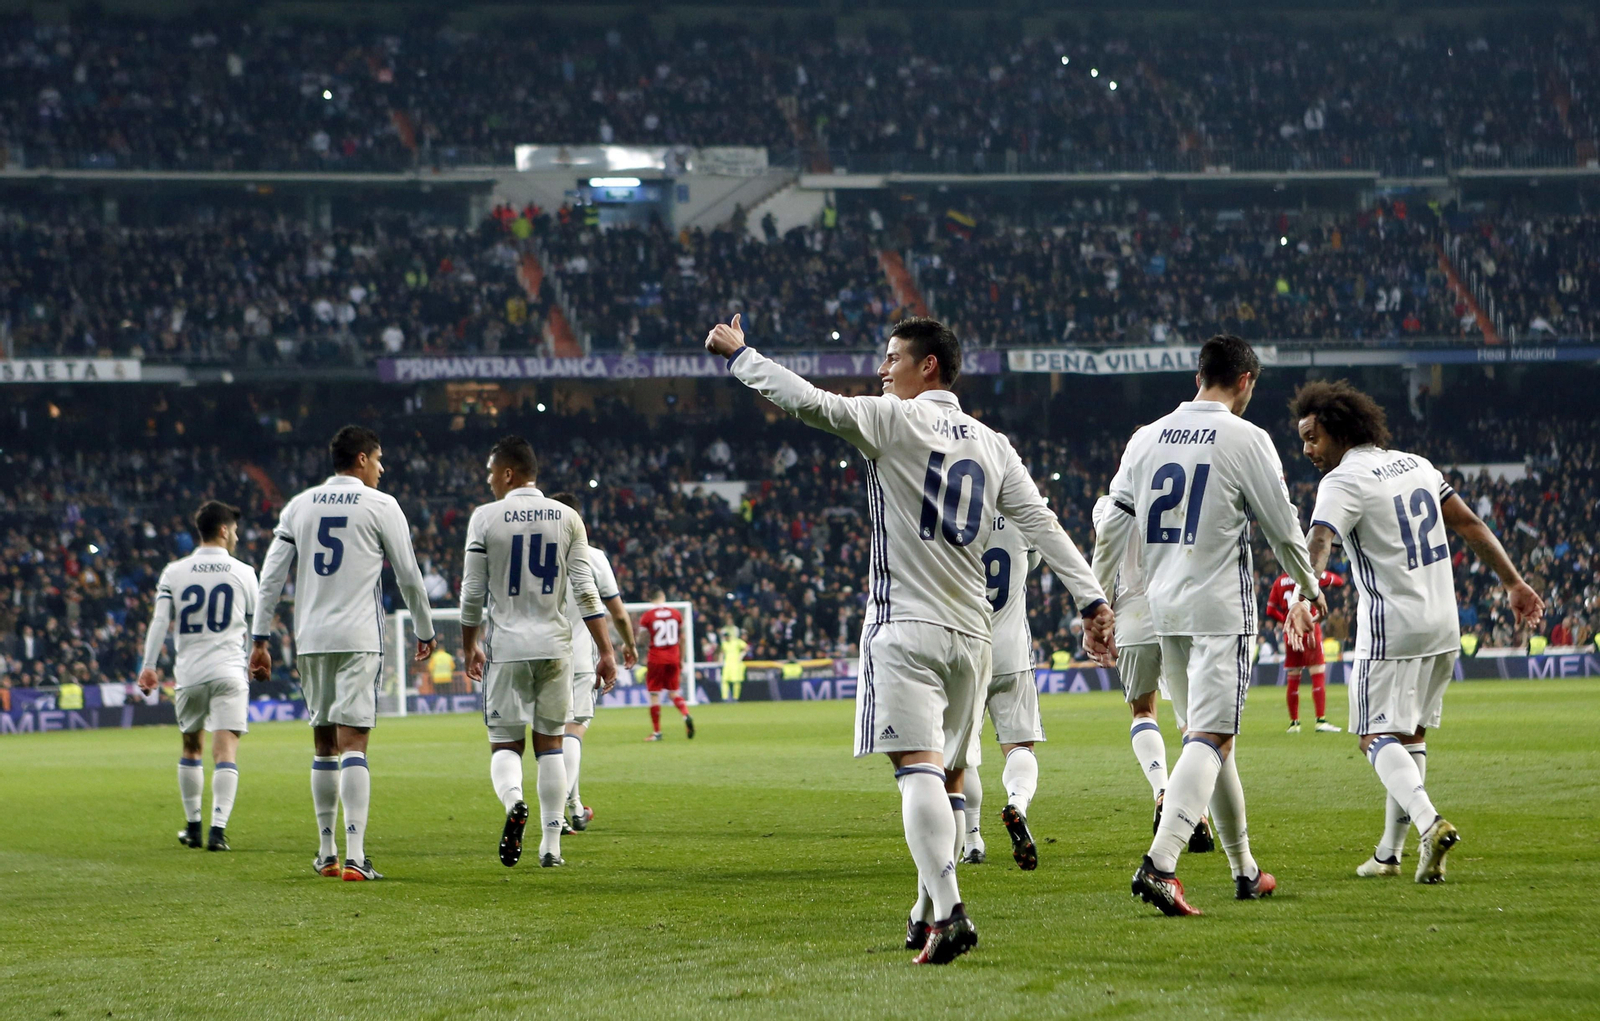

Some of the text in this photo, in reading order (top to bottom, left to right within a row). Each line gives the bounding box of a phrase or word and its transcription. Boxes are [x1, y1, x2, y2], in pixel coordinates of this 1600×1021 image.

[1511, 347, 1556, 360] Madrid
[396, 357, 521, 380] PRIMAVERA
[525, 357, 608, 377] BLANCA
[932, 416, 978, 440] JAMES
[1158, 429, 1217, 444] MORATA
[1372, 457, 1419, 482] MARCELO
[312, 493, 361, 505] VARANE
[920, 451, 985, 546] 10
[1146, 462, 1211, 545] 21
[1393, 487, 1449, 571] 12
[313, 516, 348, 577] 5
[508, 533, 559, 596] 14
[180, 583, 234, 634] 20
[653, 618, 679, 647] 20
